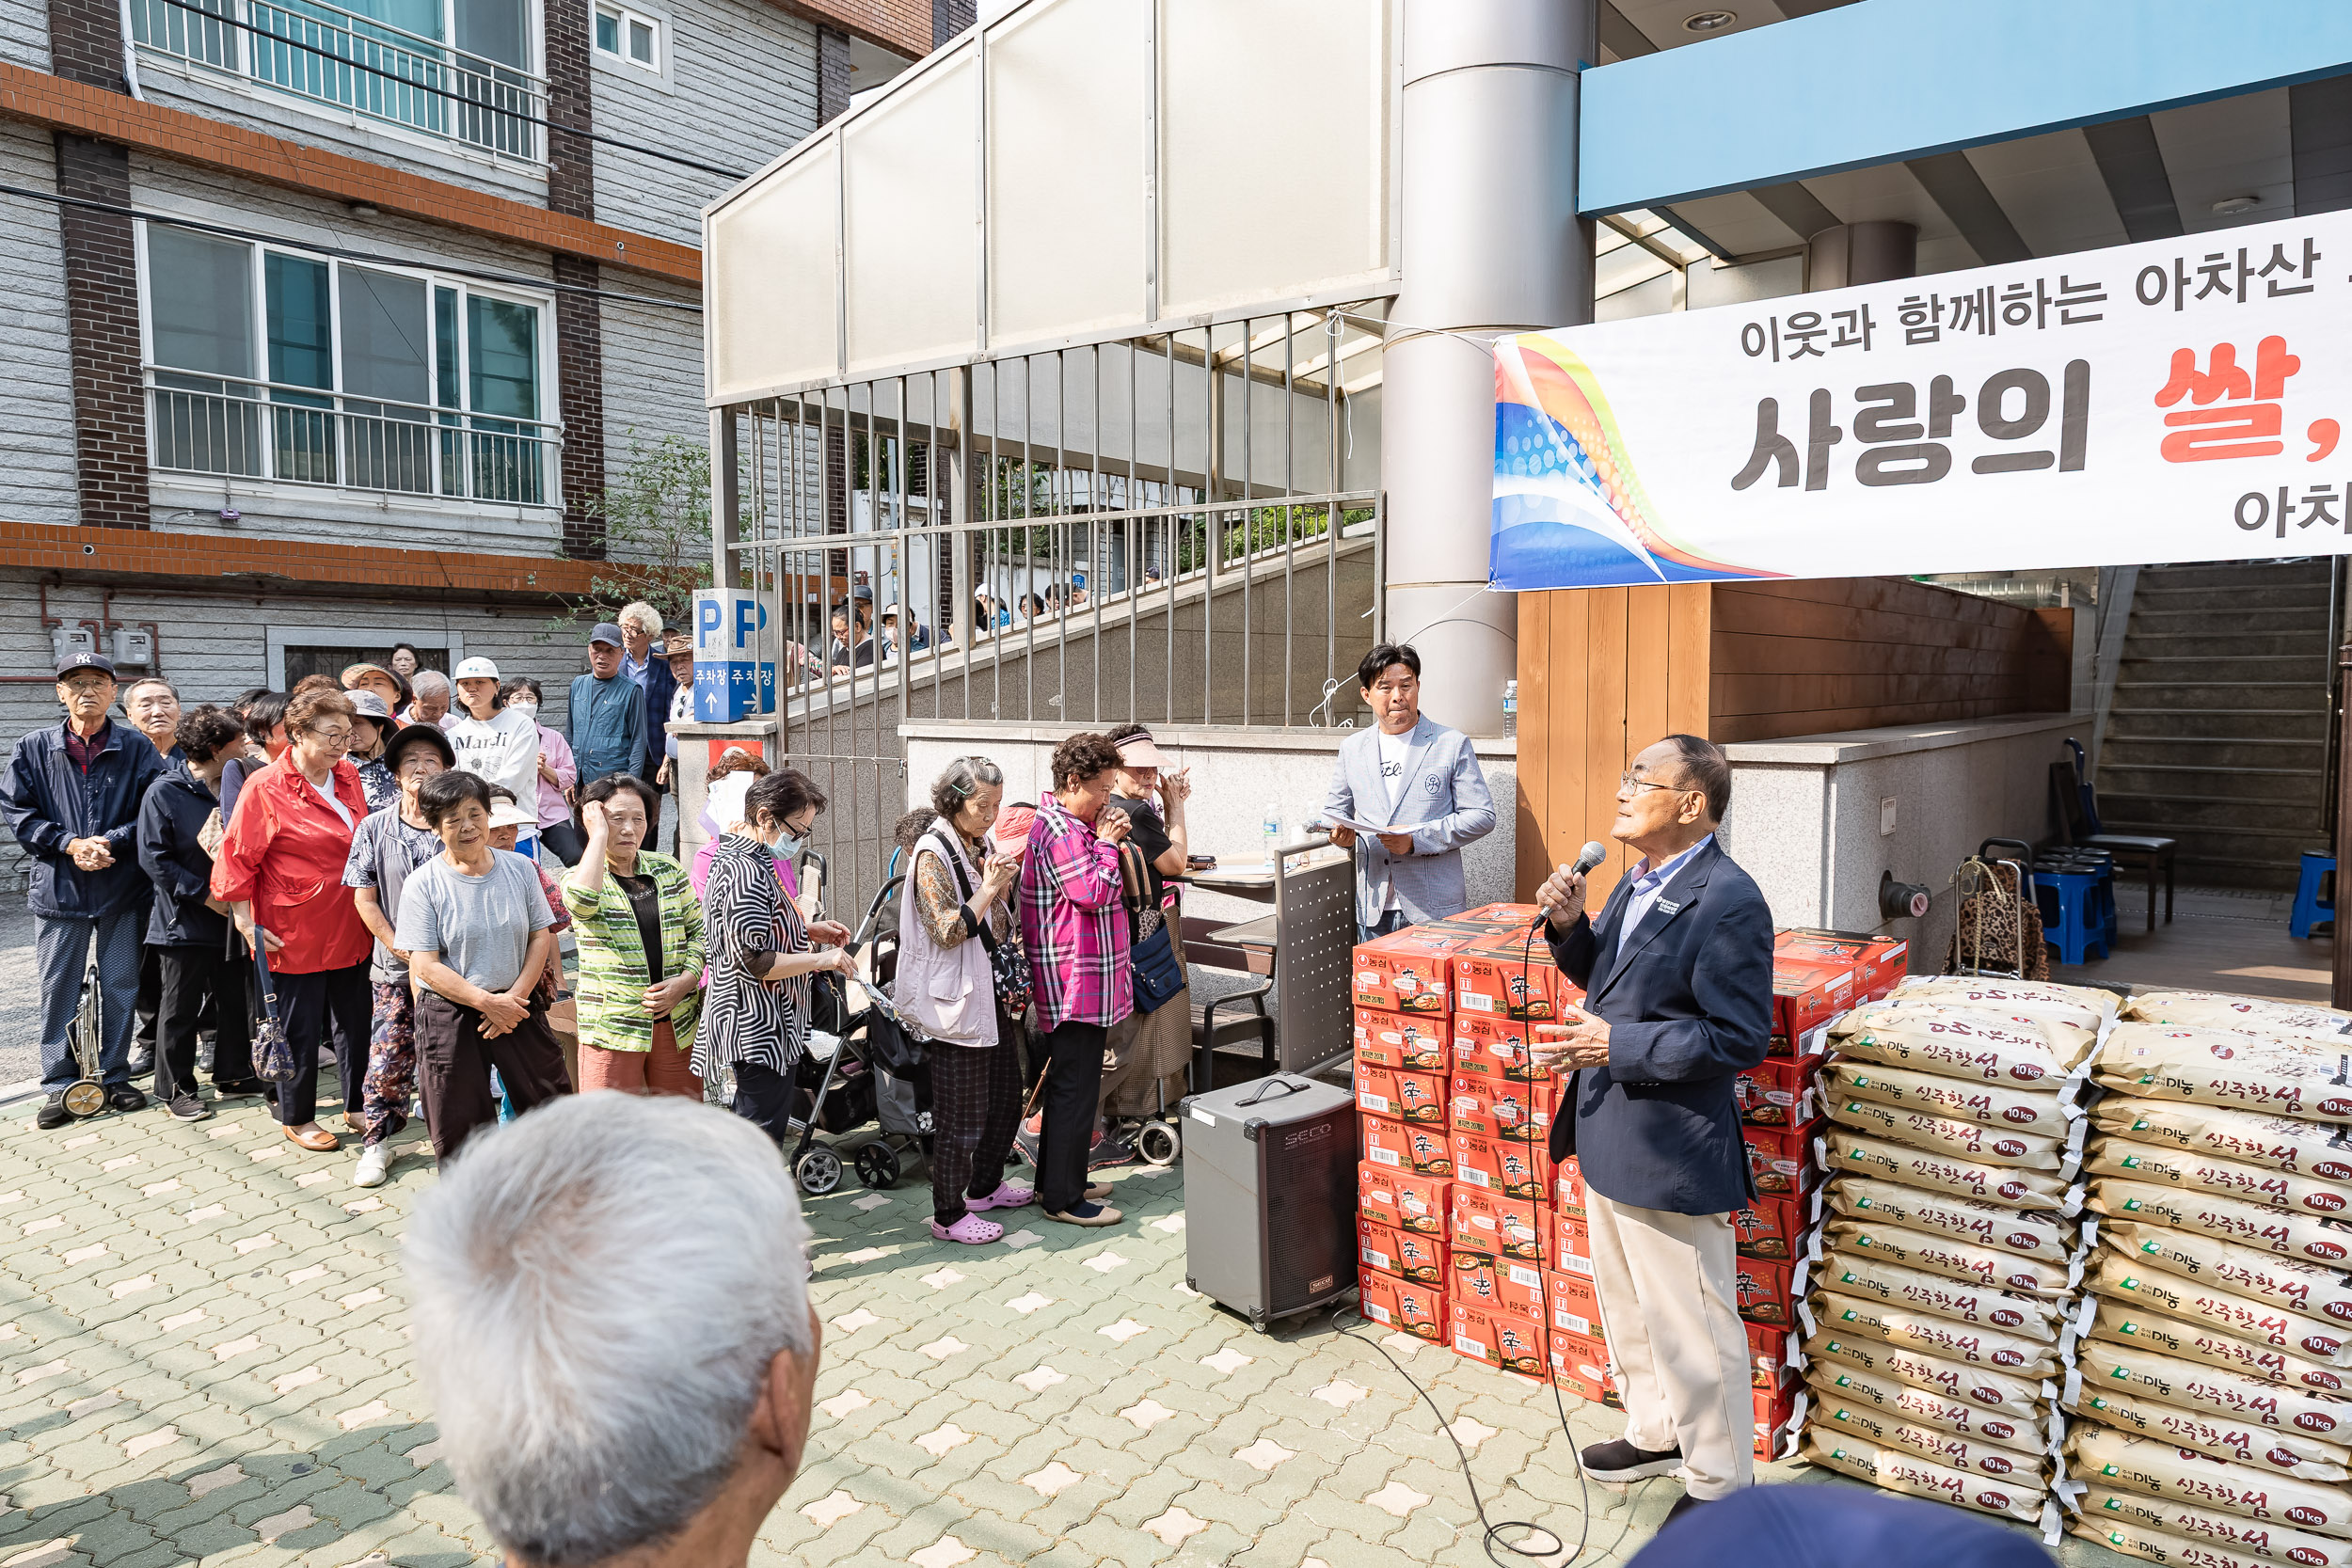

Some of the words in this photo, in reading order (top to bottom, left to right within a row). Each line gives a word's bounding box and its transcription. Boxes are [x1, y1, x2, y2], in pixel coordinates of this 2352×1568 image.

[1740, 303, 1876, 363] 이웃과
[1899, 274, 2107, 347] 함께하는
[2136, 235, 2322, 312] 아차산
[1731, 357, 2091, 492] 사랑의
[2155, 333, 2341, 464] 쌀,
[699, 600, 722, 647] P
[736, 600, 767, 647] P
[695, 670, 726, 686] 주차장
[732, 670, 772, 686] 주차장
[454, 732, 508, 750] Mardi
[1369, 958, 1386, 968] 농심
[1472, 966, 1492, 975] 농심
[1371, 1016, 1389, 1025] 농심
[1471, 1024, 1490, 1035] 농심
[1370, 1069, 1387, 1079] 농심
[1886, 1041, 1910, 1059] 미농
[1923, 1043, 1999, 1079] 신주한섬
[1468, 1084, 1486, 1094] 농심
[1883, 1084, 1903, 1100] 미농
[1915, 1085, 1992, 1120] 신주한섬
[2167, 1078, 2194, 1096] 미농
[2210, 1080, 2303, 1115] 신주한섬
[1380, 1123, 1397, 1132] 농심
[1470, 1142, 1486, 1152] 농심
[1873, 1109, 1896, 1128] 미농
[1908, 1115, 1982, 1153] 신주한섬
[2163, 1127, 2190, 1144] 미농
[2205, 1132, 2297, 1171] 신주한섬
[1373, 1176, 1389, 1186] 농심
[1876, 1155, 1899, 1173] 미농
[1912, 1160, 1986, 1195] 신주한섬
[2154, 1164, 2181, 1181] 미농
[2197, 1167, 2289, 1206] 신주한섬
[1470, 1199, 1488, 1211] 농심
[1883, 1202, 1906, 1221] 미농
[1918, 1208, 1994, 1244] 신주한섬
[1372, 1227, 1387, 1237] 농심
[1575, 1227, 1588, 1238] 농
[2156, 1206, 2183, 1225] 미농
[2198, 1212, 2290, 1252] 신주한섬
[1883, 1242, 1906, 1259] 미농
[1919, 1248, 1995, 1284] 신주한섬
[2173, 1253, 2201, 1274] 미농
[2217, 1262, 2310, 1312] 신주한섬
[1373, 1279, 1388, 1291] 농심
[1568, 1287, 1589, 1299] 농심
[1867, 1279, 1890, 1297] 미농
[1902, 1285, 1979, 1322] 신주한섬
[1467, 1313, 1485, 1325] 농심
[2152, 1287, 2180, 1309] 미농
[2195, 1297, 2288, 1346] 신주한섬
[1568, 1343, 1588, 1355] 농심
[1868, 1317, 1892, 1336] 미농
[1904, 1323, 1979, 1361] 신주한섬
[2152, 1331, 2179, 1351] 미농
[2195, 1337, 2287, 1383] 신주한섬
[1851, 1349, 1874, 1369] 미농
[1886, 1356, 1960, 1396] 신주한섬
[1861, 1386, 1883, 1404] 미농
[1897, 1392, 1971, 1433] 신주한섬
[2143, 1375, 2170, 1396] 미농
[2186, 1382, 2280, 1426] 신주한섬
[1860, 1418, 1883, 1437] 미농
[1895, 1427, 1969, 1467] 신주한섬
[2120, 1409, 2147, 1429] 미농
[2162, 1416, 2253, 1462] 신주한섬
[1856, 1458, 1878, 1477] 미농
[1891, 1466, 1966, 1503] 신주한섬
[2134, 1471, 2161, 1492] 미농
[2176, 1478, 2271, 1519] 신주한섬
[2136, 1507, 2163, 1527] 미농
[2178, 1514, 2273, 1557] 신주한섬
[2139, 1542, 2167, 1561] 미농
